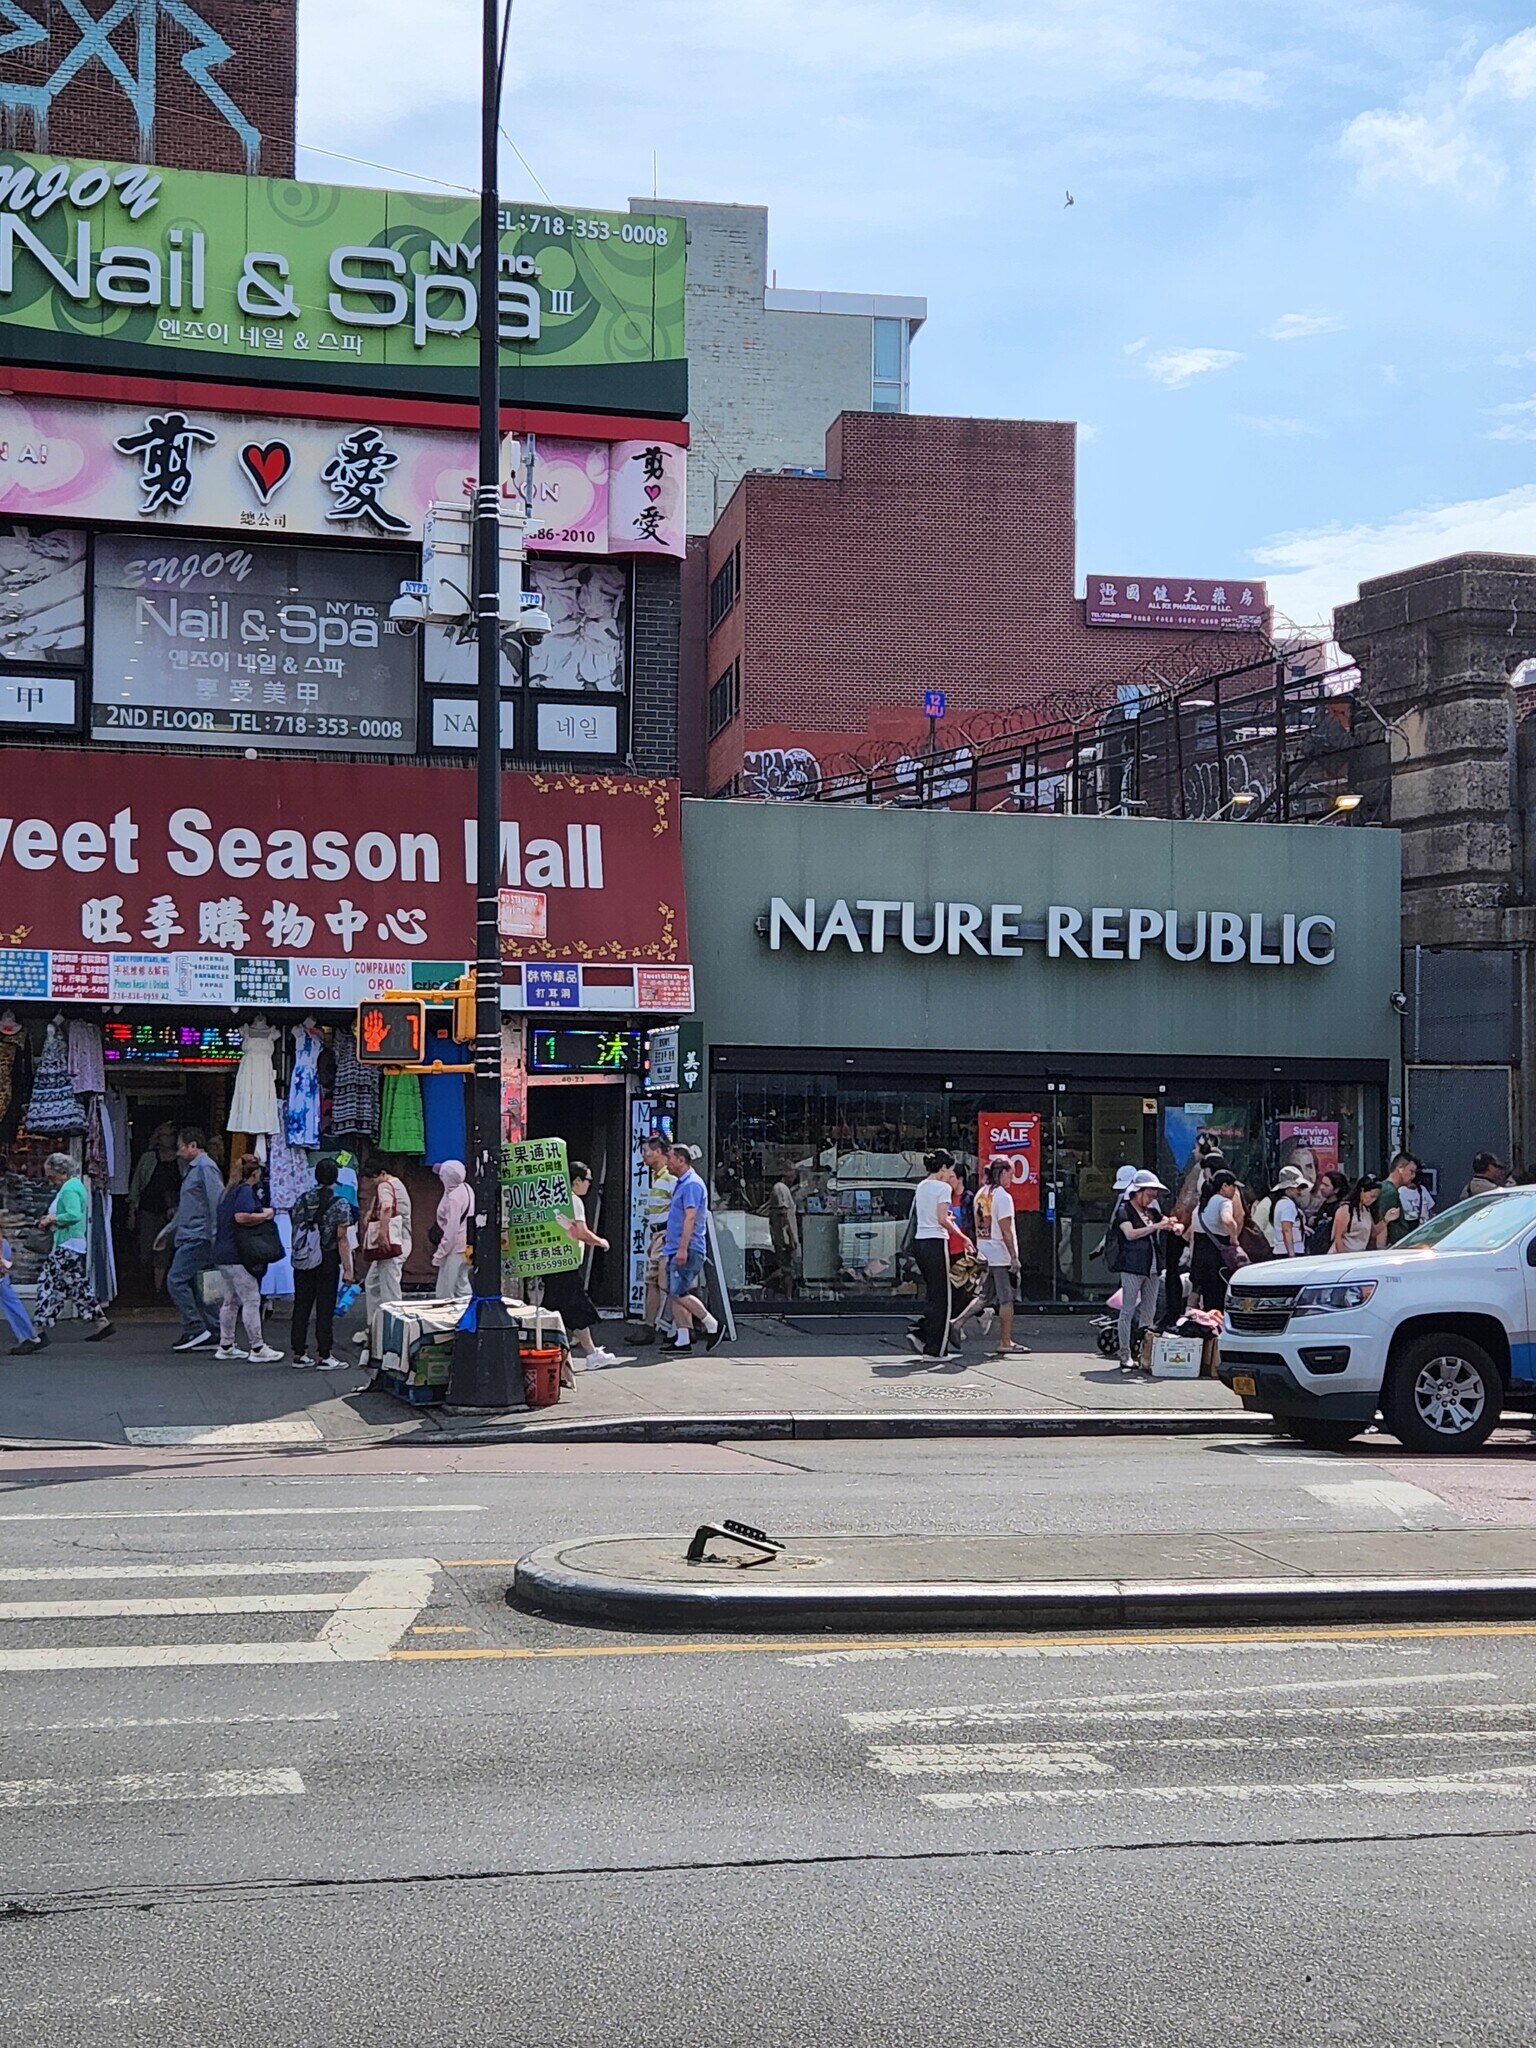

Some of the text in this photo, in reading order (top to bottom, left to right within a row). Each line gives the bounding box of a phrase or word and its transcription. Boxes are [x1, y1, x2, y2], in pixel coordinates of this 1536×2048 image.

[498, 252, 543, 278] nc.
[0, 211, 205, 312] Nail
[237, 252, 301, 318] &
[329, 245, 541, 349] Spa
[158, 318, 364, 355] 엔조이 네일 & 스파
[112, 411, 412, 533] 剪 愛
[462, 477, 559, 502] SLON
[631, 446, 673, 547] 剪 愛
[122, 550, 254, 588] ENJOY
[405, 582, 428, 594] NYPD
[326, 602, 380, 618] NY Inc.
[1148, 602, 1161, 610] ALL
[1172, 603, 1210, 612] PHARMACY
[135, 596, 228, 641] Nail
[240, 609, 271, 643] &
[279, 604, 379, 653] Spa
[168, 648, 345, 679] 엔조이 네일 & 스파
[16, 686, 44, 713] 甲
[195, 678, 320, 705] 享受美甲
[929, 694, 941, 705] 12
[106, 705, 148, 727] 2ND
[152, 708, 215, 731] FLOOR
[926, 706, 944, 717] MU
[556, 716, 598, 740] 네일
[167, 807, 441, 882] Season
[81, 895, 429, 951] 旺季購物中心
[769, 896, 1336, 967] NATURE REPUBLIC
[296, 964, 348, 980] We Buy
[354, 962, 407, 975] COMPRAMOS
[673, 973, 687, 981] Shop
[304, 986, 341, 1000] Gold
[368, 978, 393, 990] ORO
[683, 1051, 700, 1089] 美甲
[990, 1128, 1029, 1142] SALE
[1293, 1126, 1330, 1136] Survive
[1309, 1137, 1335, 1146] HEAT
[500, 1142, 562, 1166] 苹果通讯
[513, 1210, 547, 1223] 送手机
